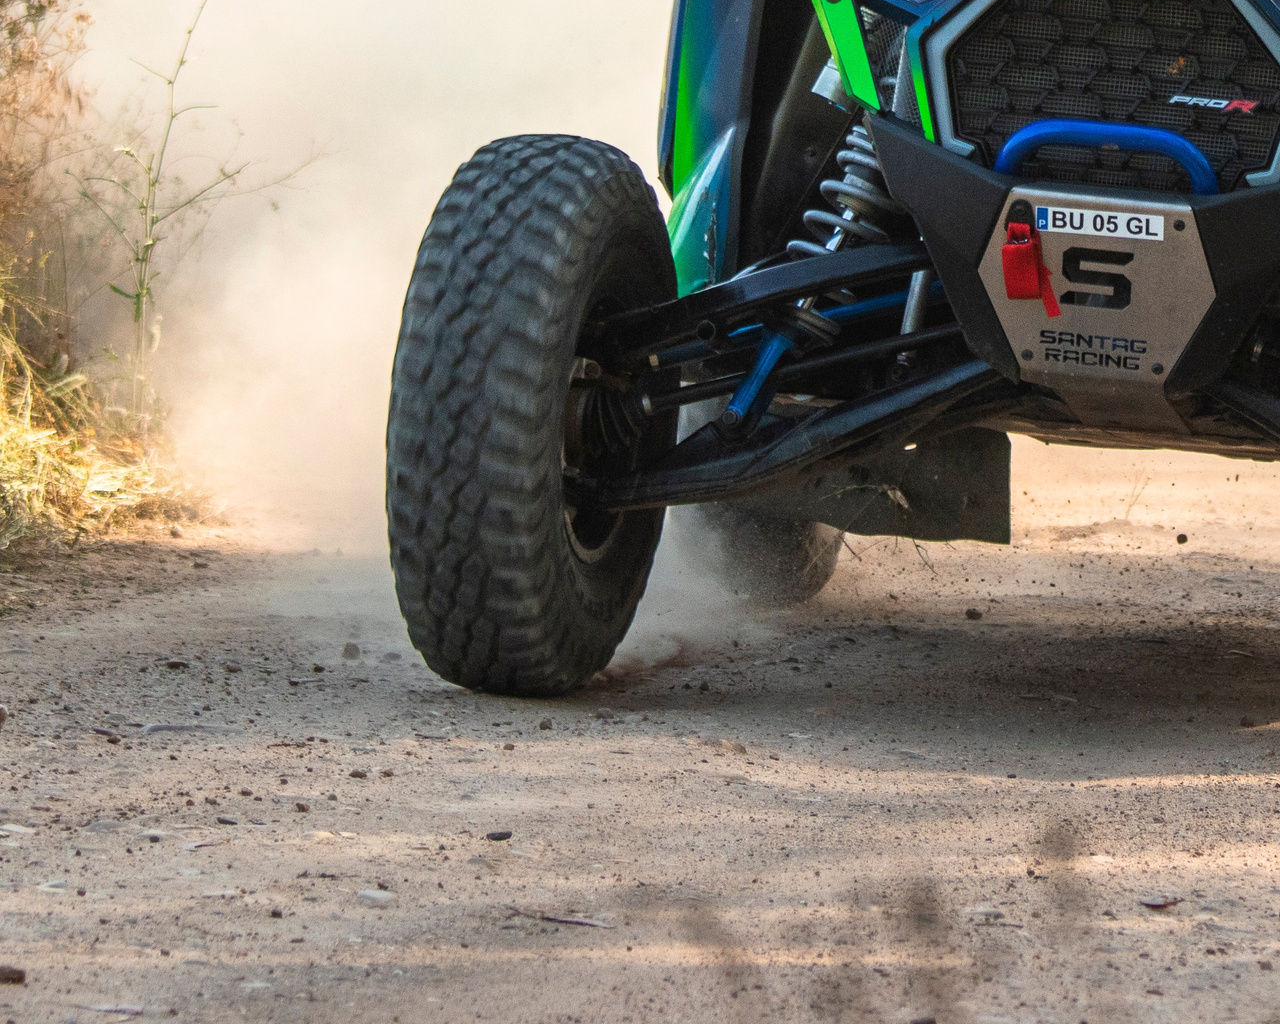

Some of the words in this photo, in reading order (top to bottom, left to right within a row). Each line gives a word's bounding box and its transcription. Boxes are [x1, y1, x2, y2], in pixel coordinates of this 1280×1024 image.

[1038, 219, 1046, 227] P
[1052, 211, 1084, 230] BU
[1092, 214, 1118, 233] 05
[1126, 217, 1158, 236] GL
[1060, 247, 1134, 309] S
[1040, 330, 1147, 354] SANTAG
[1045, 348, 1140, 370] RACING
